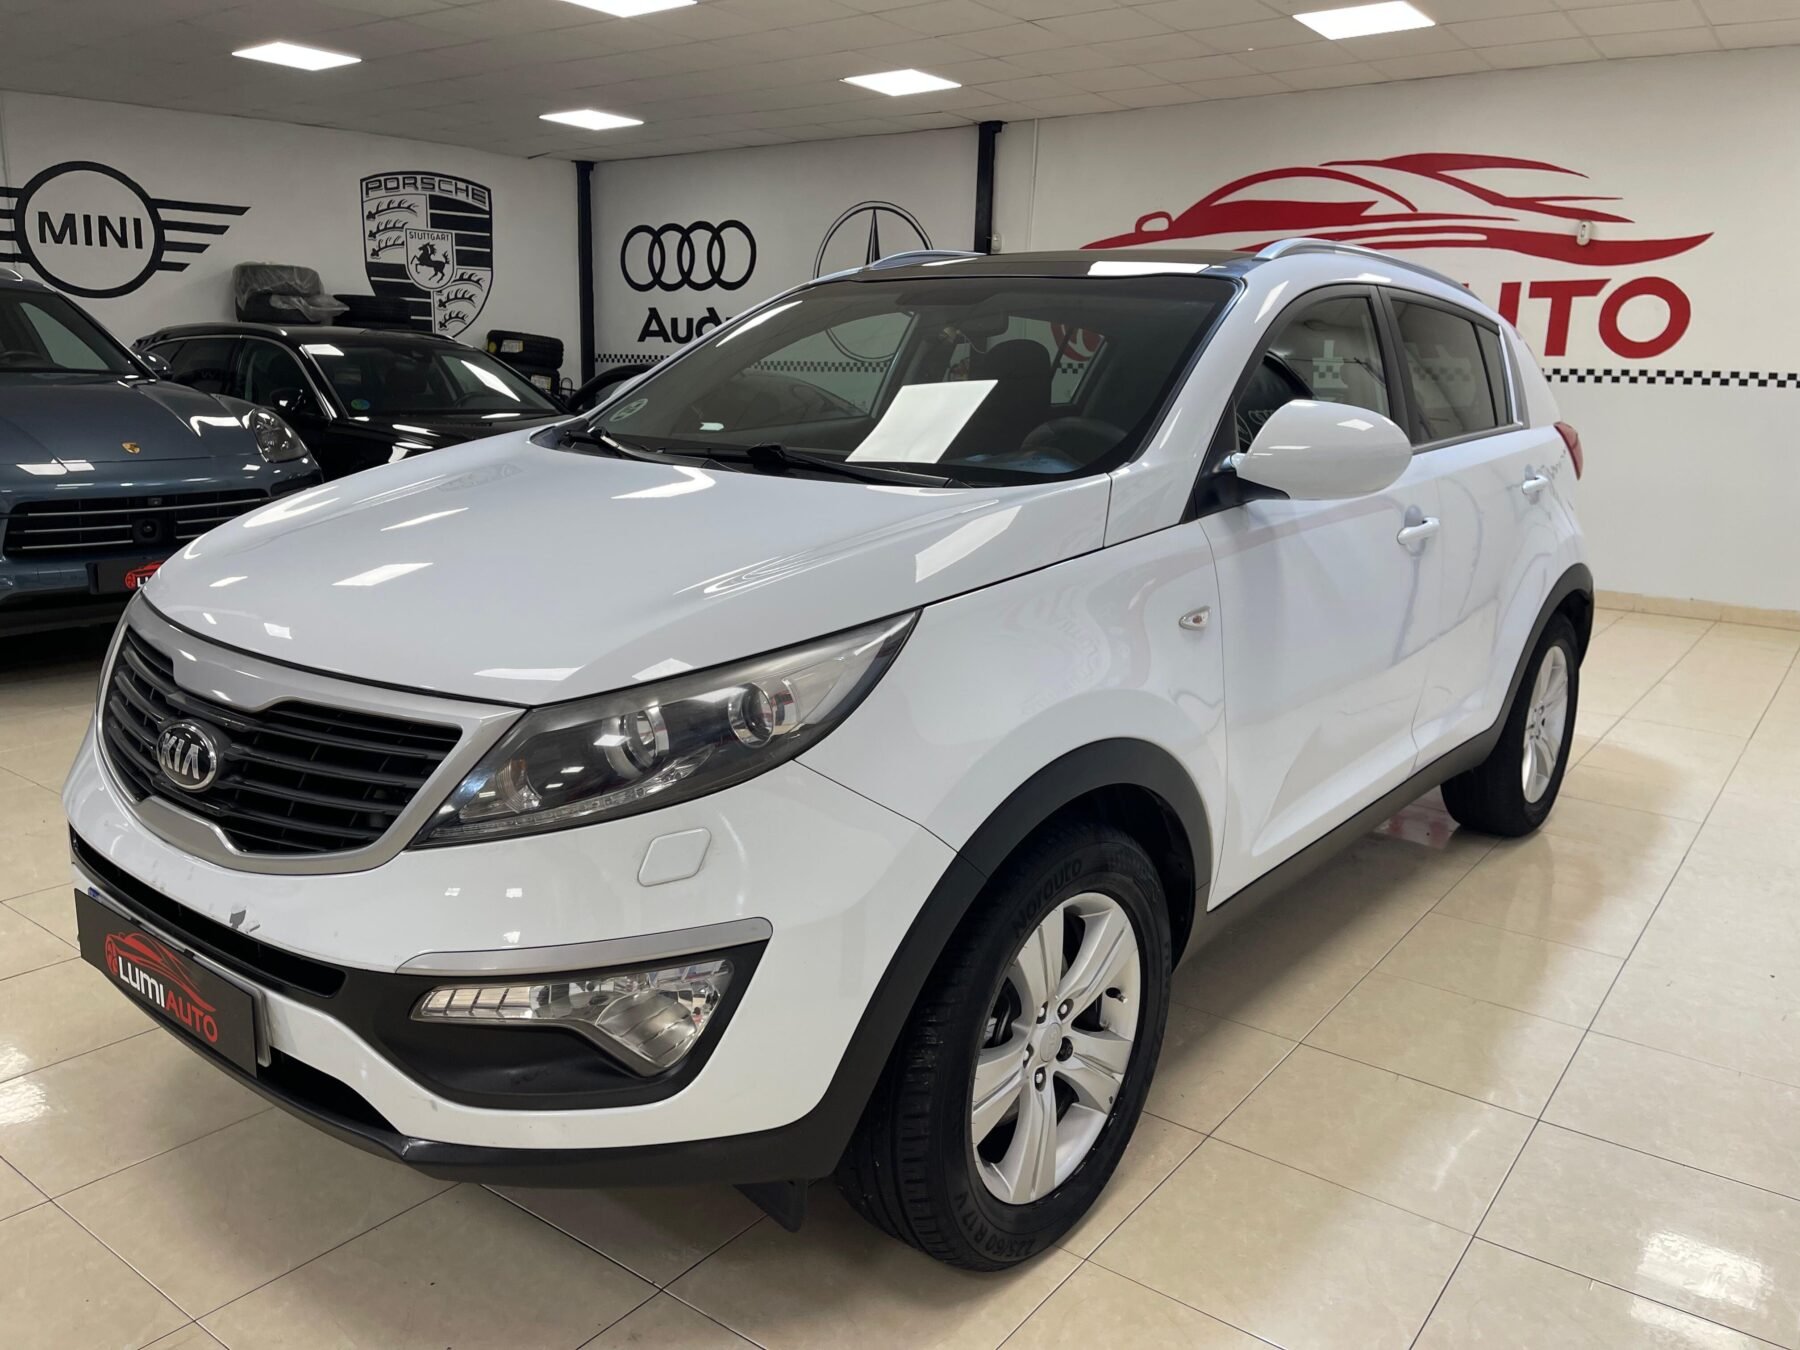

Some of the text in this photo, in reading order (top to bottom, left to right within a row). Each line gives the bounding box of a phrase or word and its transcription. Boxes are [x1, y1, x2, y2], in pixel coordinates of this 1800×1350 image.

[365, 176, 488, 207] PORSCHE
[38, 211, 143, 249] MINI
[409, 231, 450, 242] STUTTGART
[637, 307, 732, 344] Aud
[161, 732, 200, 780] KIA
